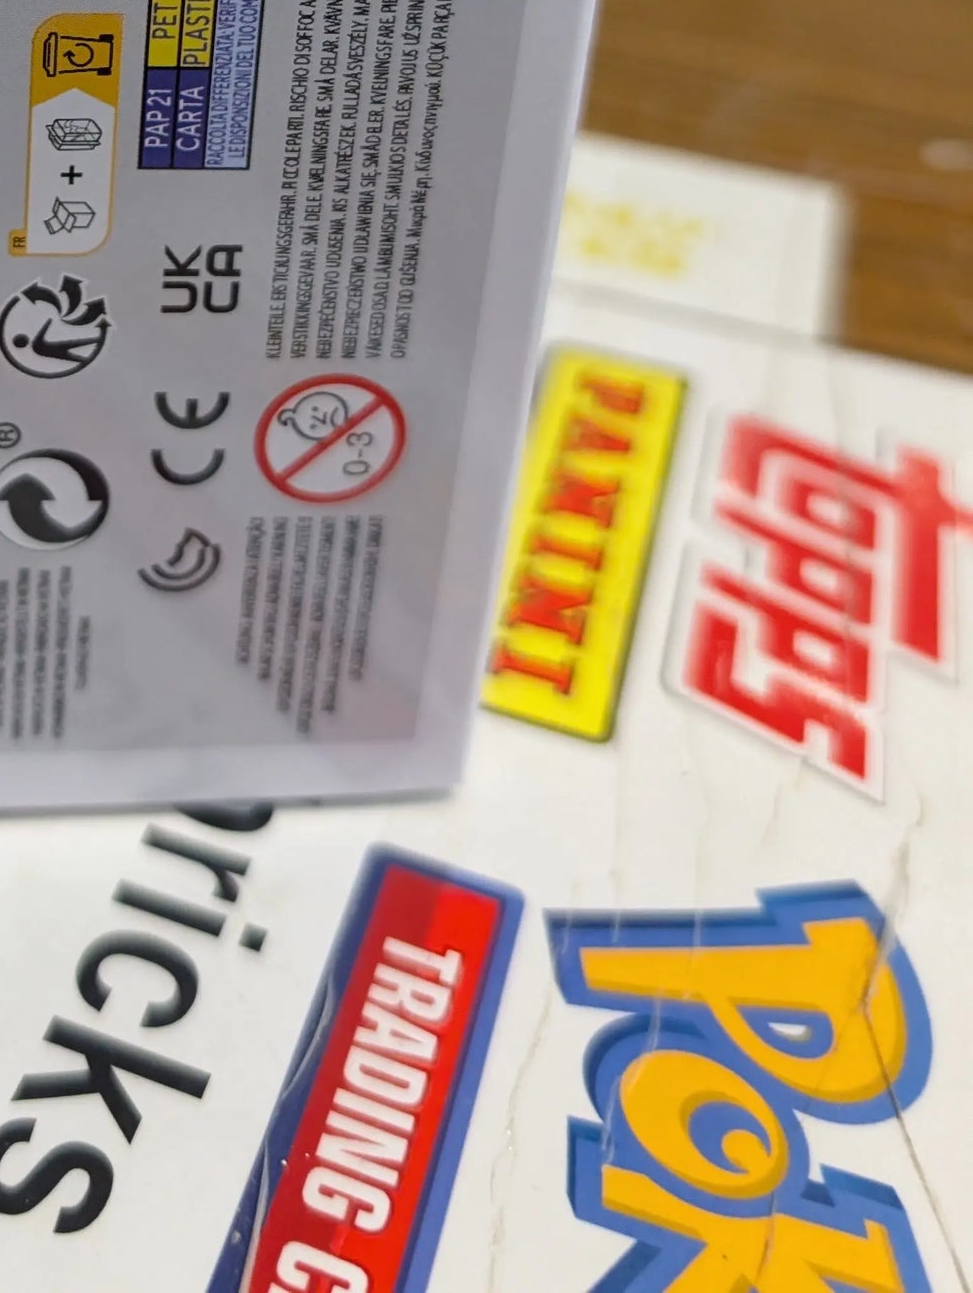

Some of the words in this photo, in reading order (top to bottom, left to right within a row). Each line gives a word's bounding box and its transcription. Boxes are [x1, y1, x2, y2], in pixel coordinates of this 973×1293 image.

[152, 4, 177, 39] PET
[147, 89, 172, 106] 21
[176, 86, 204, 152] CARTA
[144, 110, 170, 148] PAP
[207, 112, 228, 166] RACCOLTA
[13, 236, 26, 248] FR
[160, 244, 202, 313] UK
[202, 244, 243, 313] CA
[149, 391, 230, 485] CE
[342, 431, 374, 476] 0-3
[488, 370, 646, 697] PANINI
[302, 934, 463, 1235] TRADING
